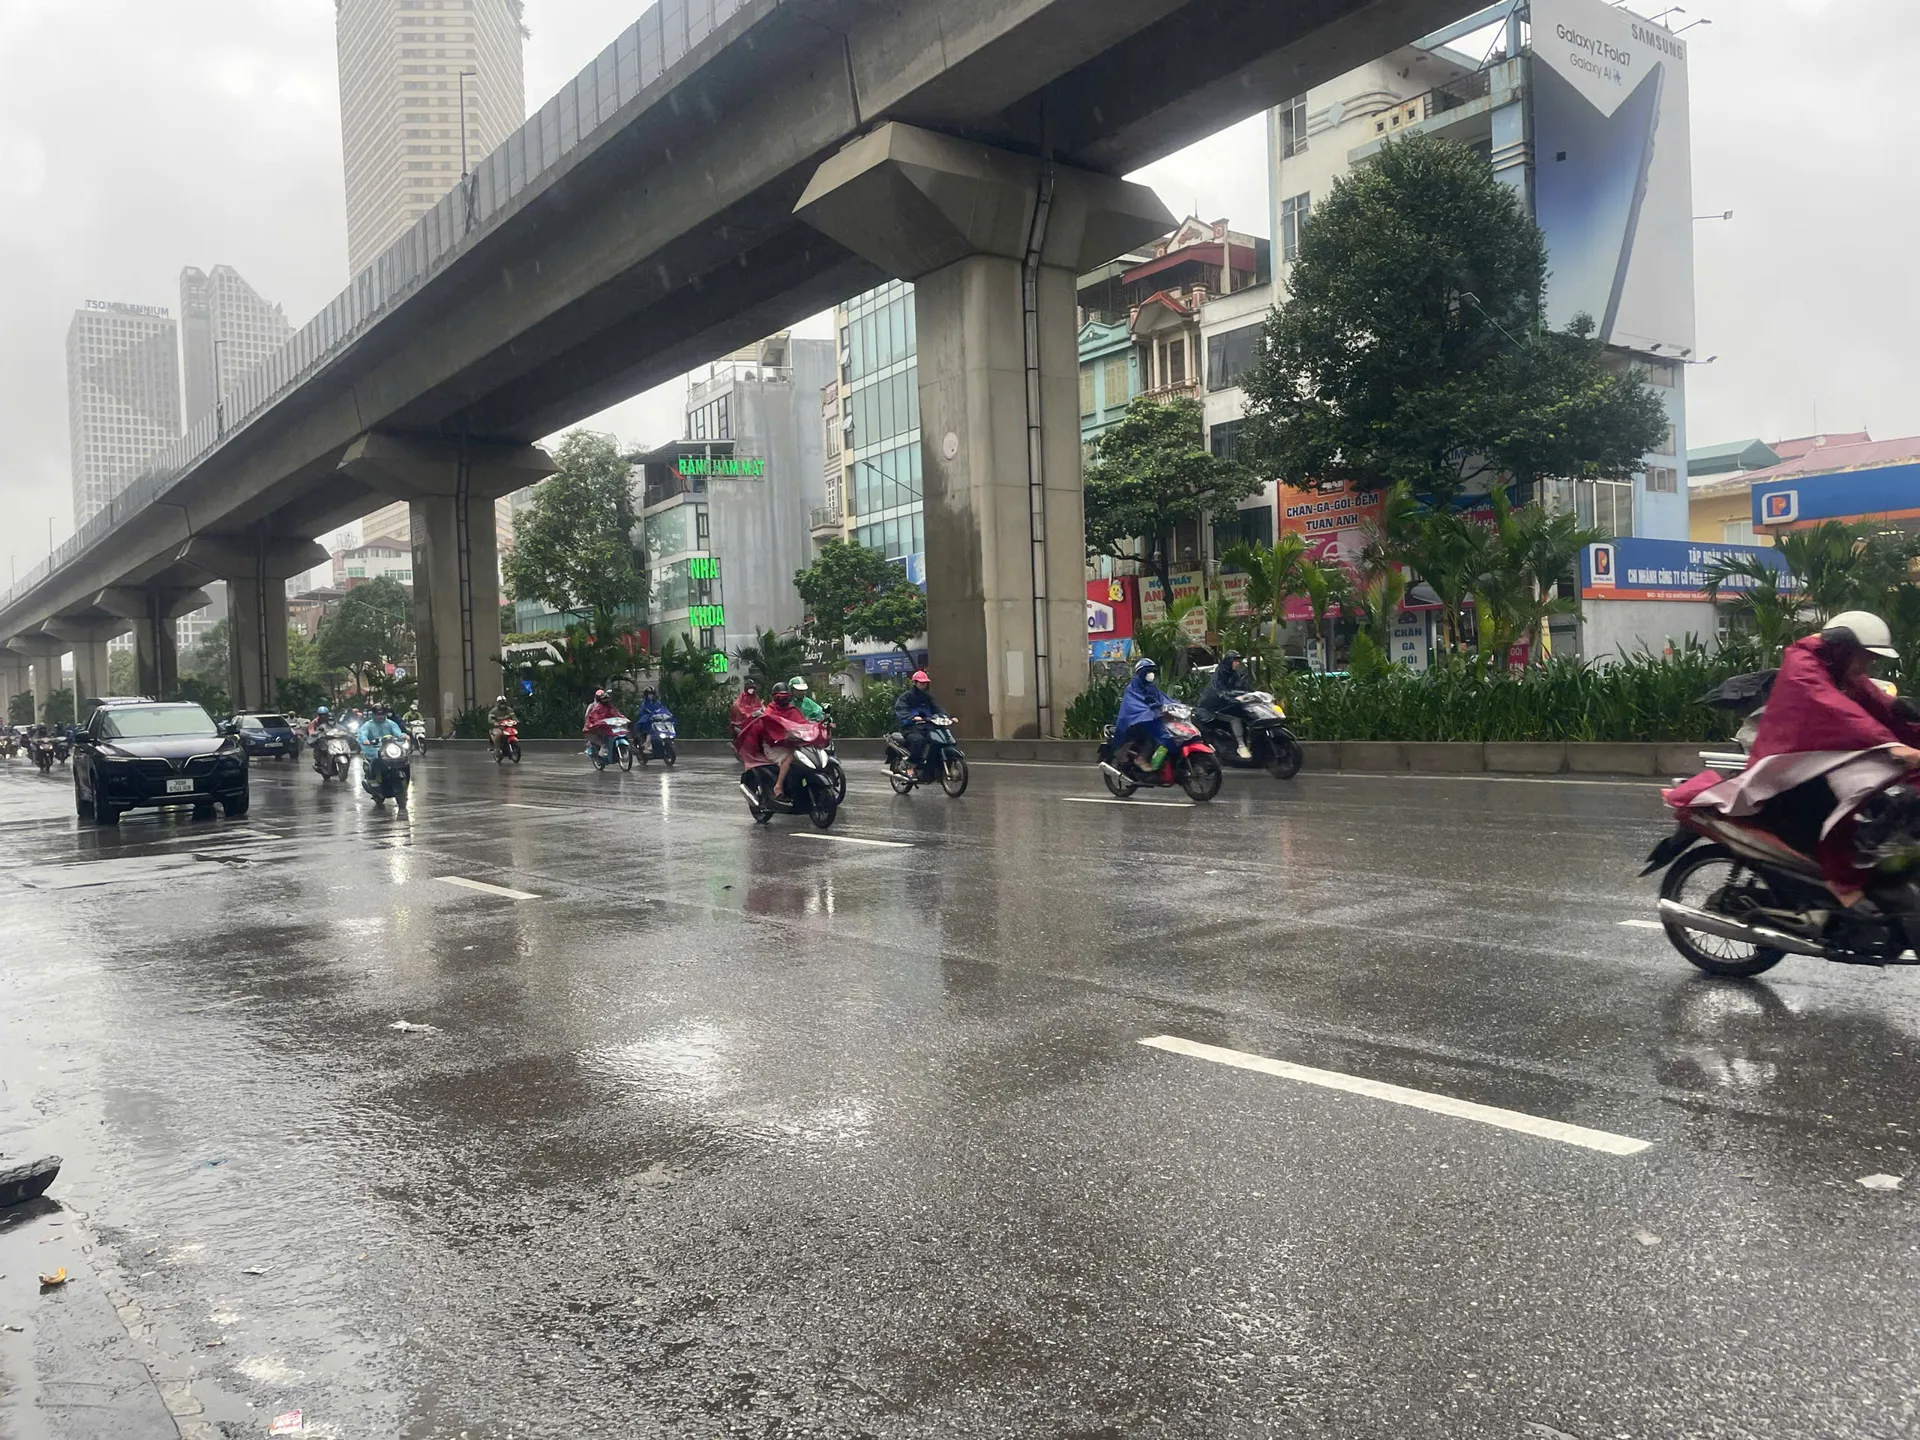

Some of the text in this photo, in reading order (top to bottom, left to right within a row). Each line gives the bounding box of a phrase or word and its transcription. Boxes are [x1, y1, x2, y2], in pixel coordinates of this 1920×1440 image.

[1556, 24, 1631, 66] Galaxy Z Fold7
[1631, 23, 1684, 61] SAMSUNG
[1569, 53, 1601, 79] Galaxy
[85, 300, 106, 310] TSO
[1336, 513, 1359, 527] ANH
[690, 558, 718, 579] NHA
[689, 605, 725, 628] KHOA
[1402, 642, 1415, 651] GA
